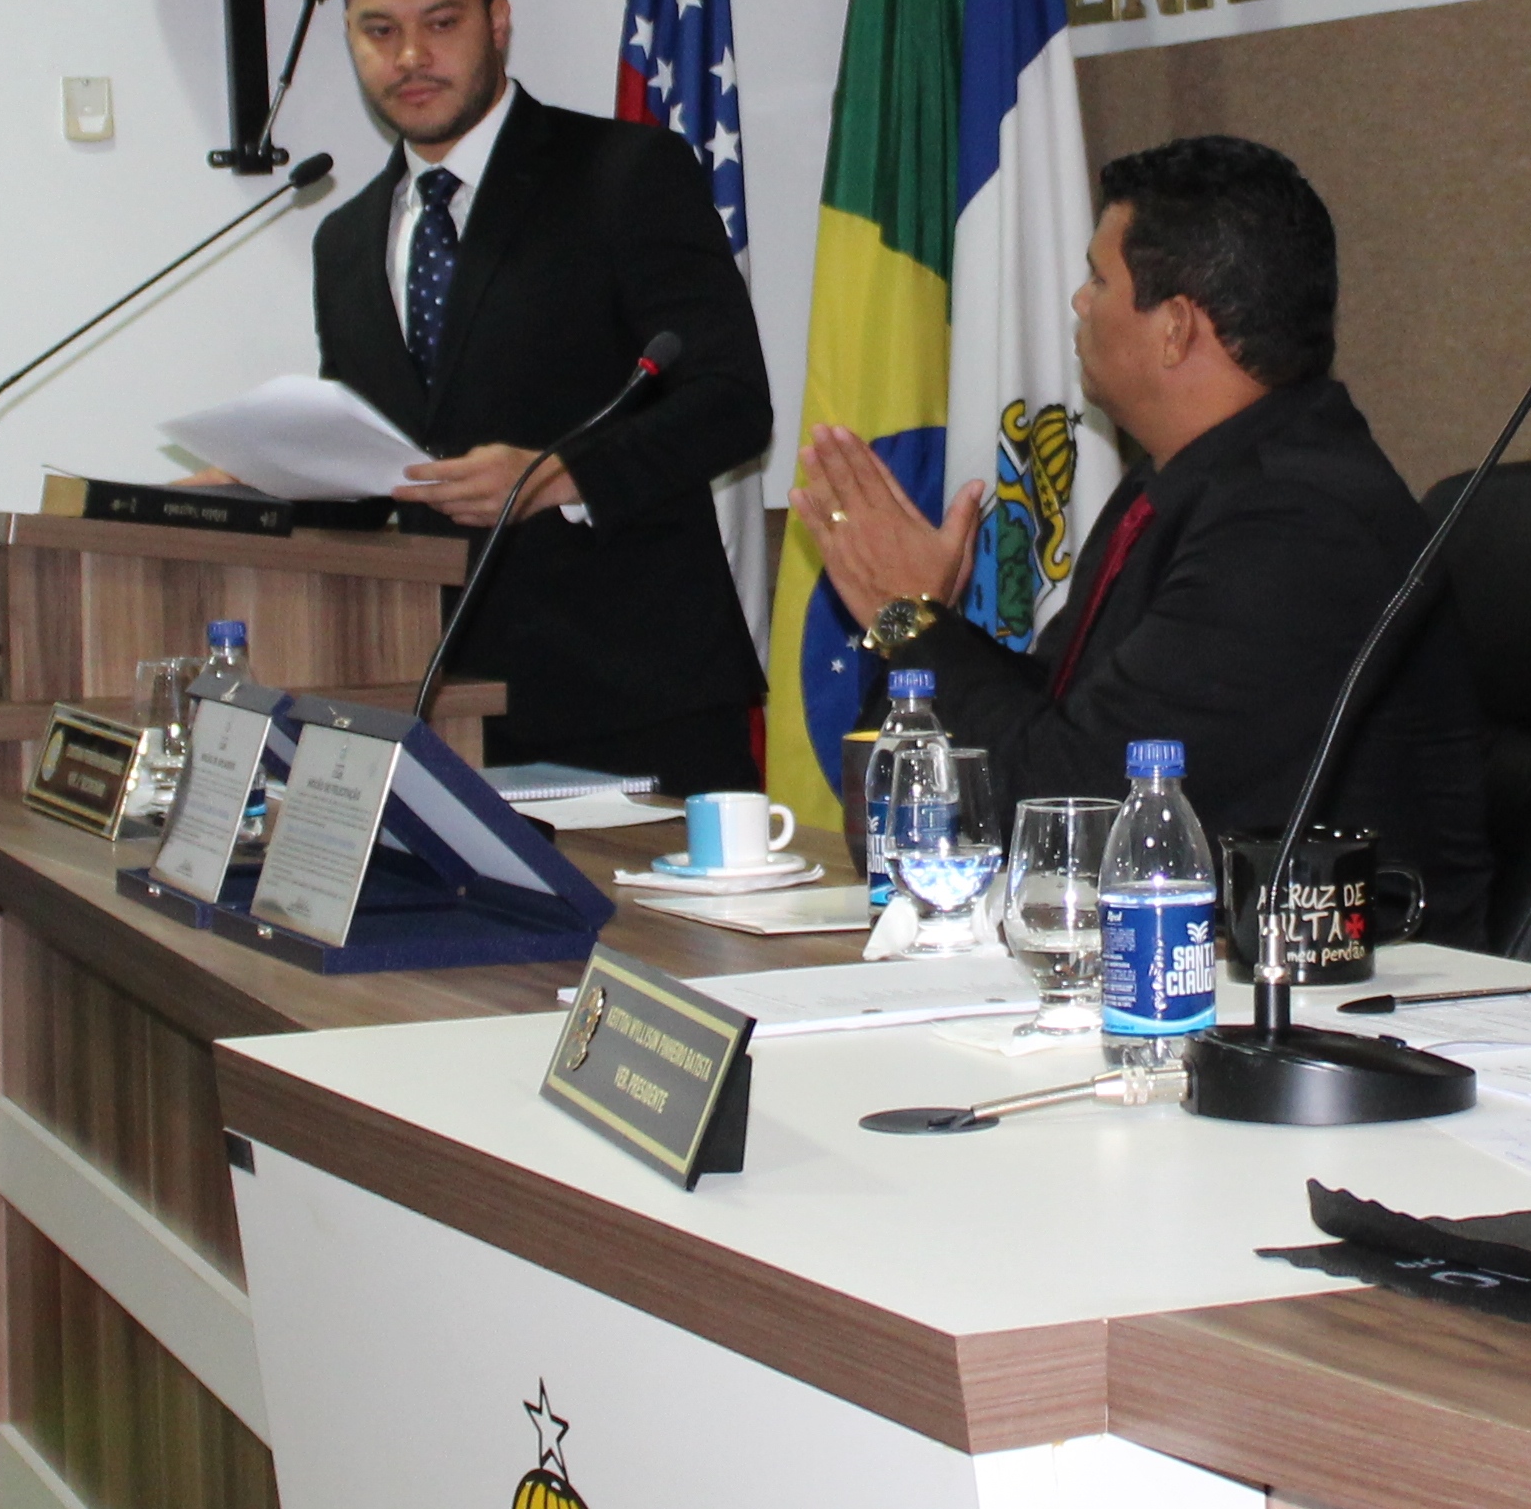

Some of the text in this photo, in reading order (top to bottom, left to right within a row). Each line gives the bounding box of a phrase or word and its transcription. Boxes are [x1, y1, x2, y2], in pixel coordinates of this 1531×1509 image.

[1343, 882, 1365, 907] DE
[1258, 910, 1343, 943] LTA
[1286, 949, 1316, 964] meu
[1166, 967, 1215, 997] CLAUD
